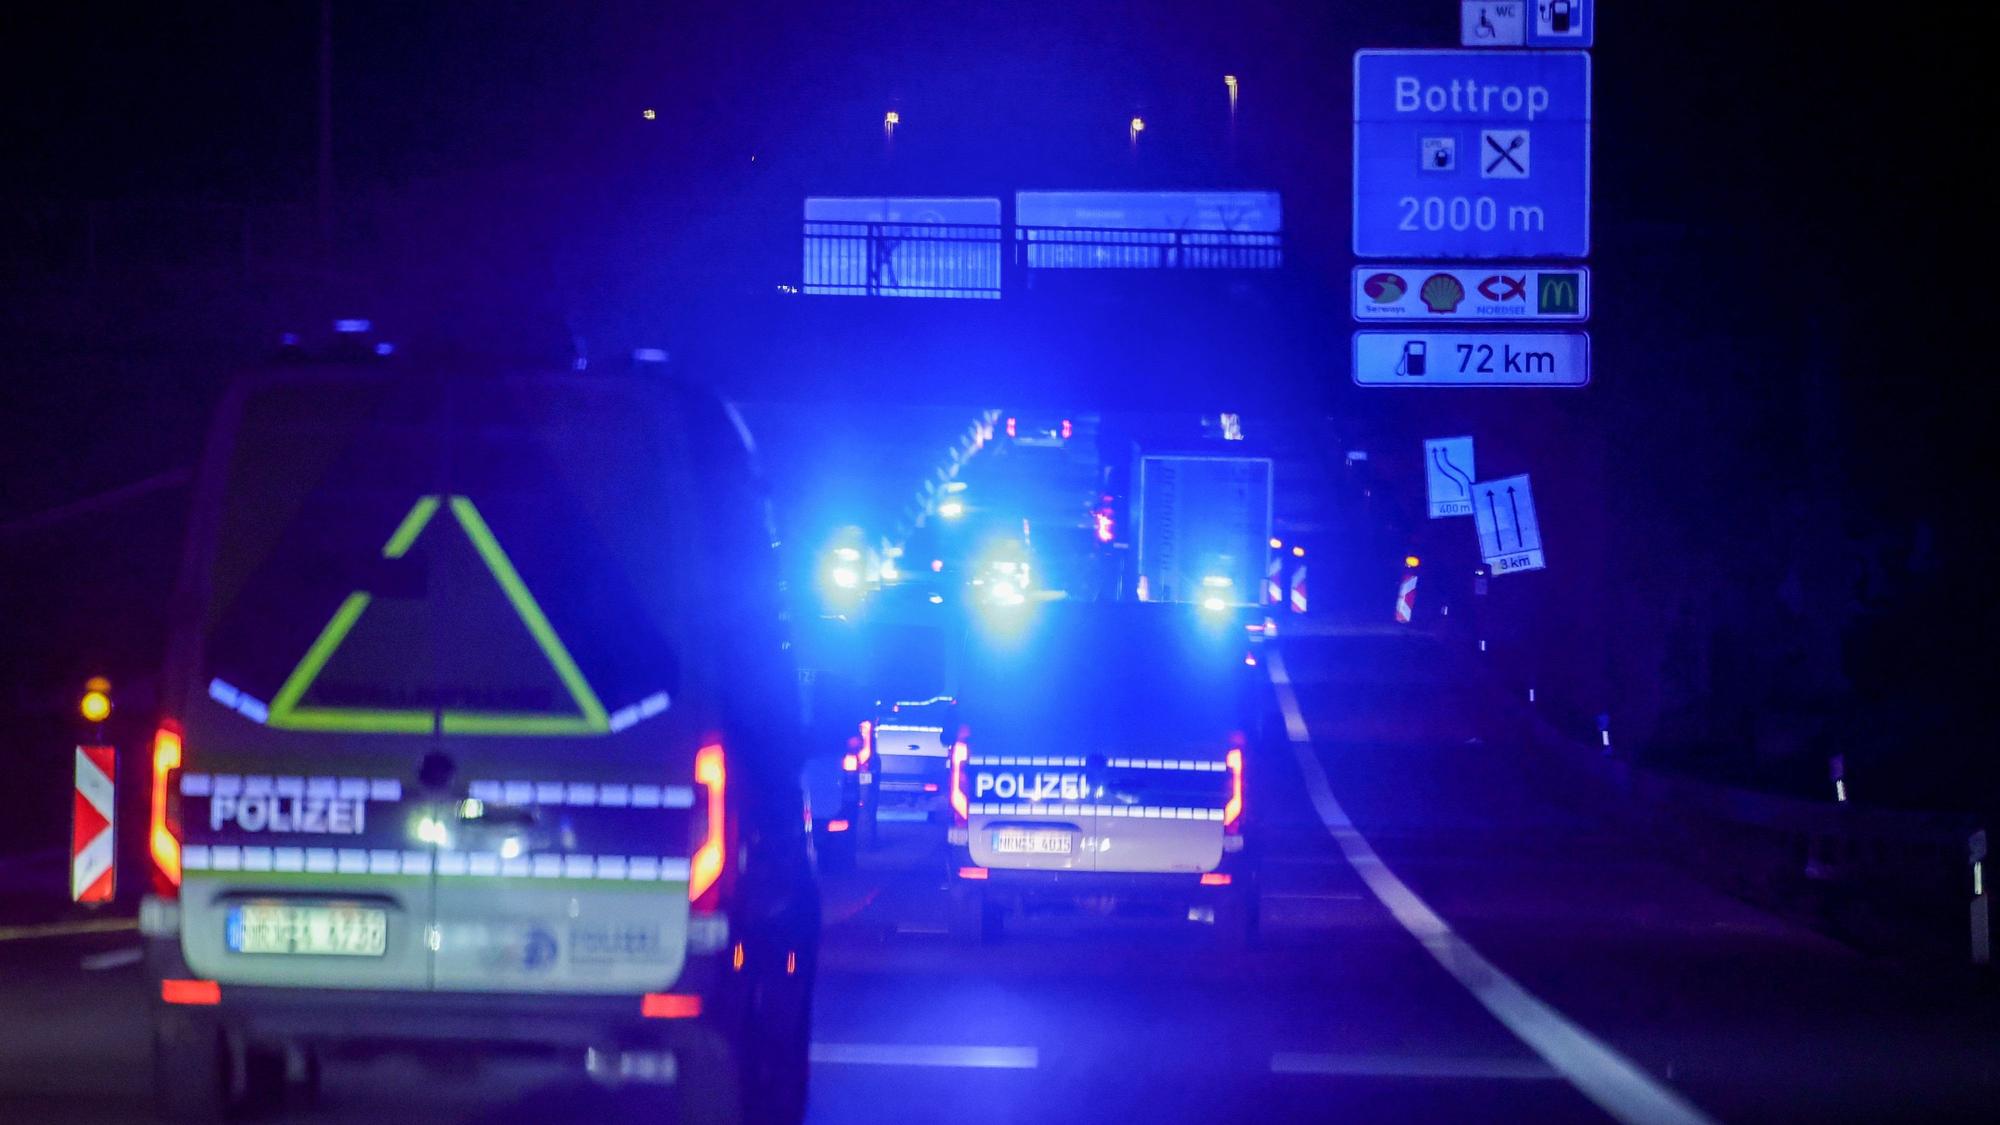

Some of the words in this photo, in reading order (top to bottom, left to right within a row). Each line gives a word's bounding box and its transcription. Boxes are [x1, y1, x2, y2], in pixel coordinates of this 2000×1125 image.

[1496, 5, 1516, 18] WC
[1395, 76, 1550, 122] Bottrop
[1399, 196, 1497, 231] 2000
[1508, 205, 1544, 232] m
[1456, 344, 1493, 373] 72
[1504, 344, 1555, 373] km
[1501, 559, 1508, 570] 3
[1511, 556, 1531, 568] km
[976, 773, 1087, 799] POLIZEI
[210, 796, 365, 834] POLIZEI
